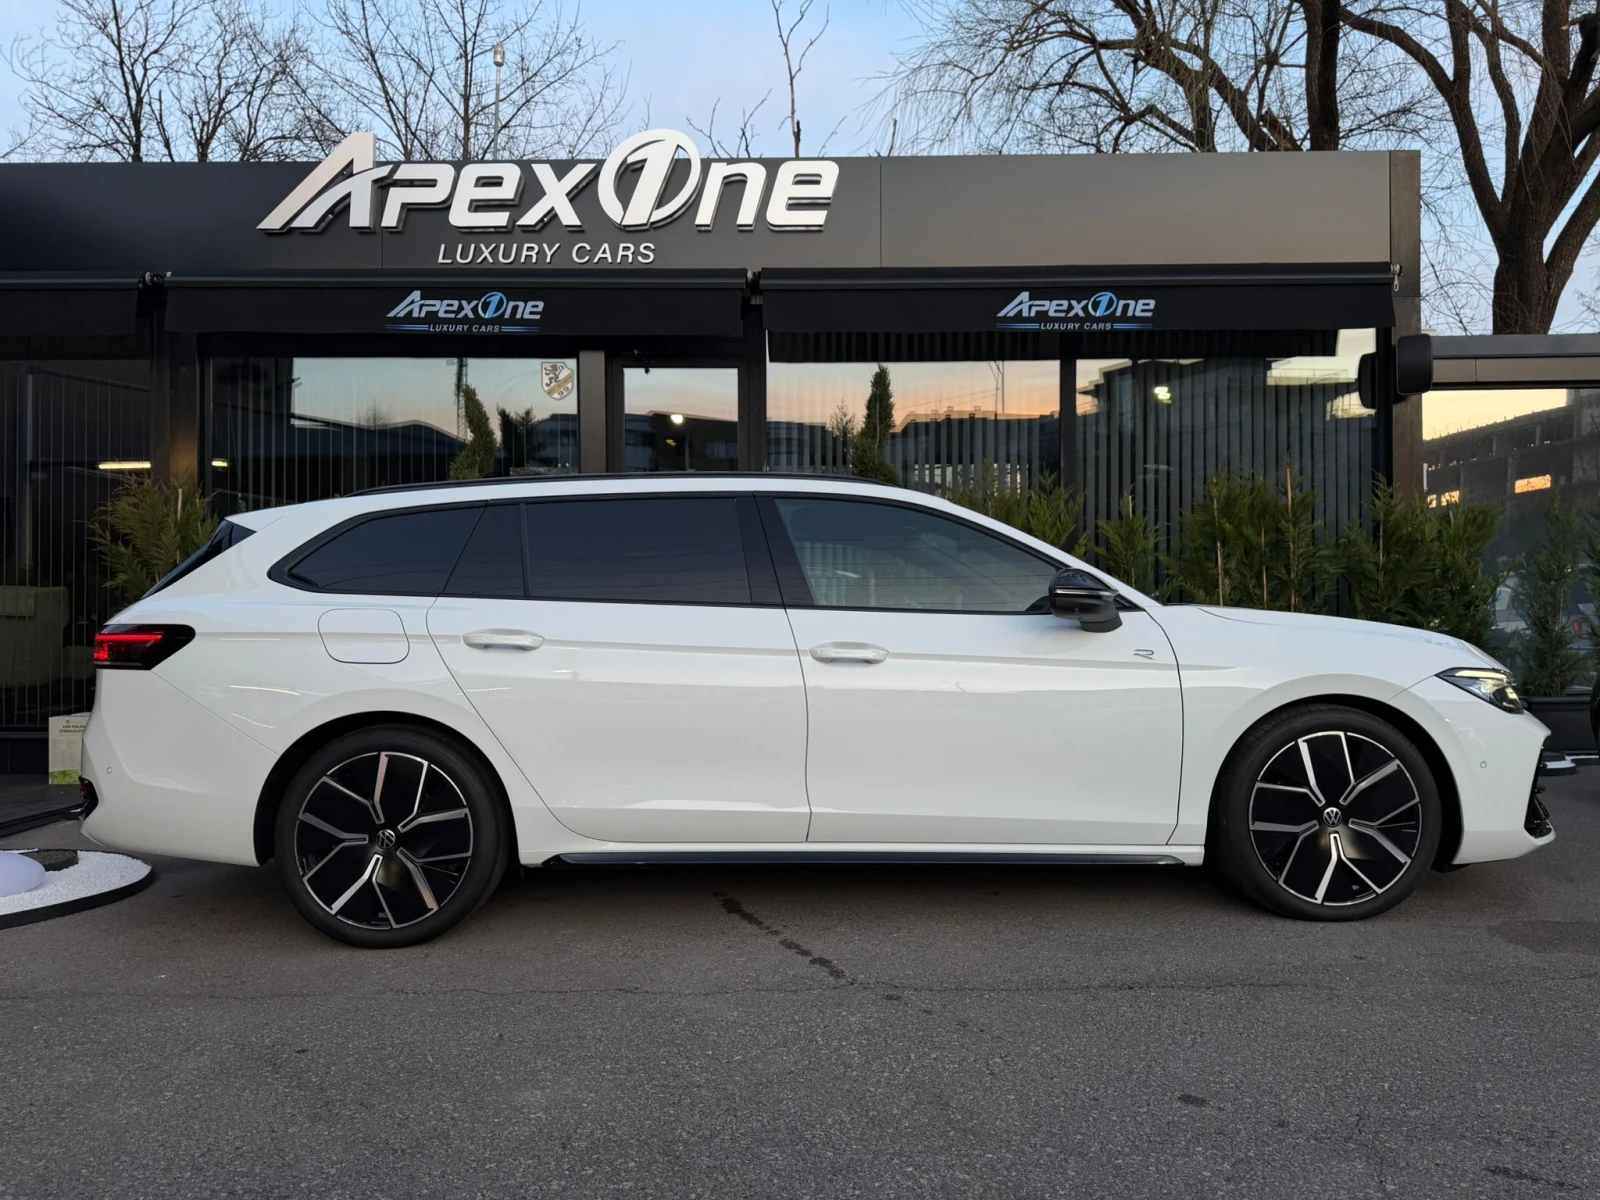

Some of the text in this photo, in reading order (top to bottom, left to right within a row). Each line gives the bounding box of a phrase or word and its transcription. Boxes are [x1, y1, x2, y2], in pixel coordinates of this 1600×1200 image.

[437, 242, 656, 265] LUXURY CARS
[430, 324, 500, 332] LUXURY CARS
[1040, 322, 1112, 330] LUXURY CARS
